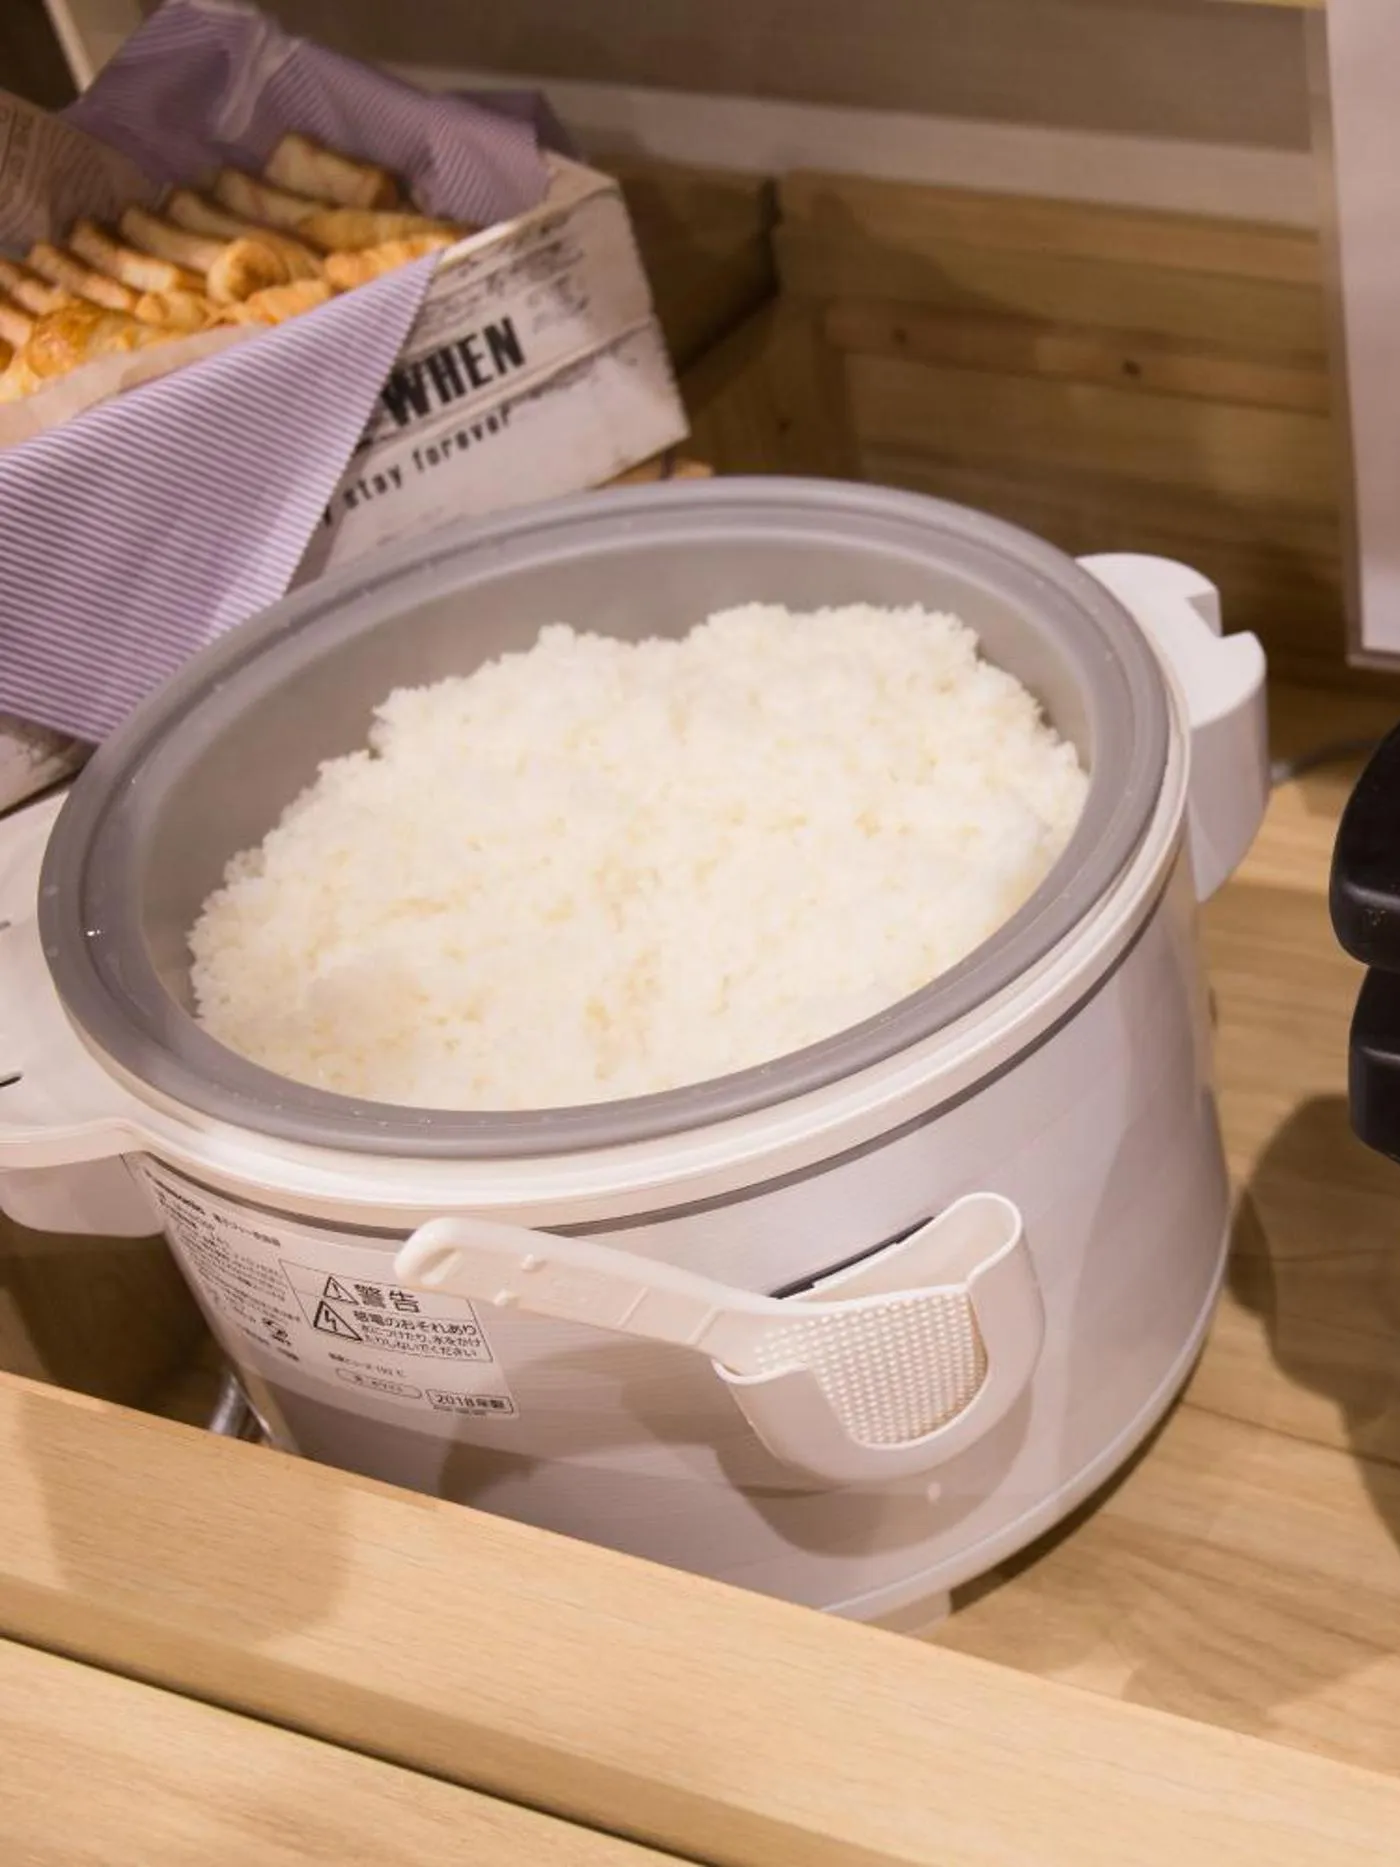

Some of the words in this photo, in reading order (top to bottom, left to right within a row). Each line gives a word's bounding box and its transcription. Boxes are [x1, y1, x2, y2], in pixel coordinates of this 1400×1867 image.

[381, 317, 526, 427] WHEN
[342, 463, 403, 509] stay
[412, 403, 513, 474] forever
[354, 1283, 420, 1313] 警告
[353, 1310, 477, 1336] 感電のおそれあり
[436, 1394, 506, 1409] 2018年製
